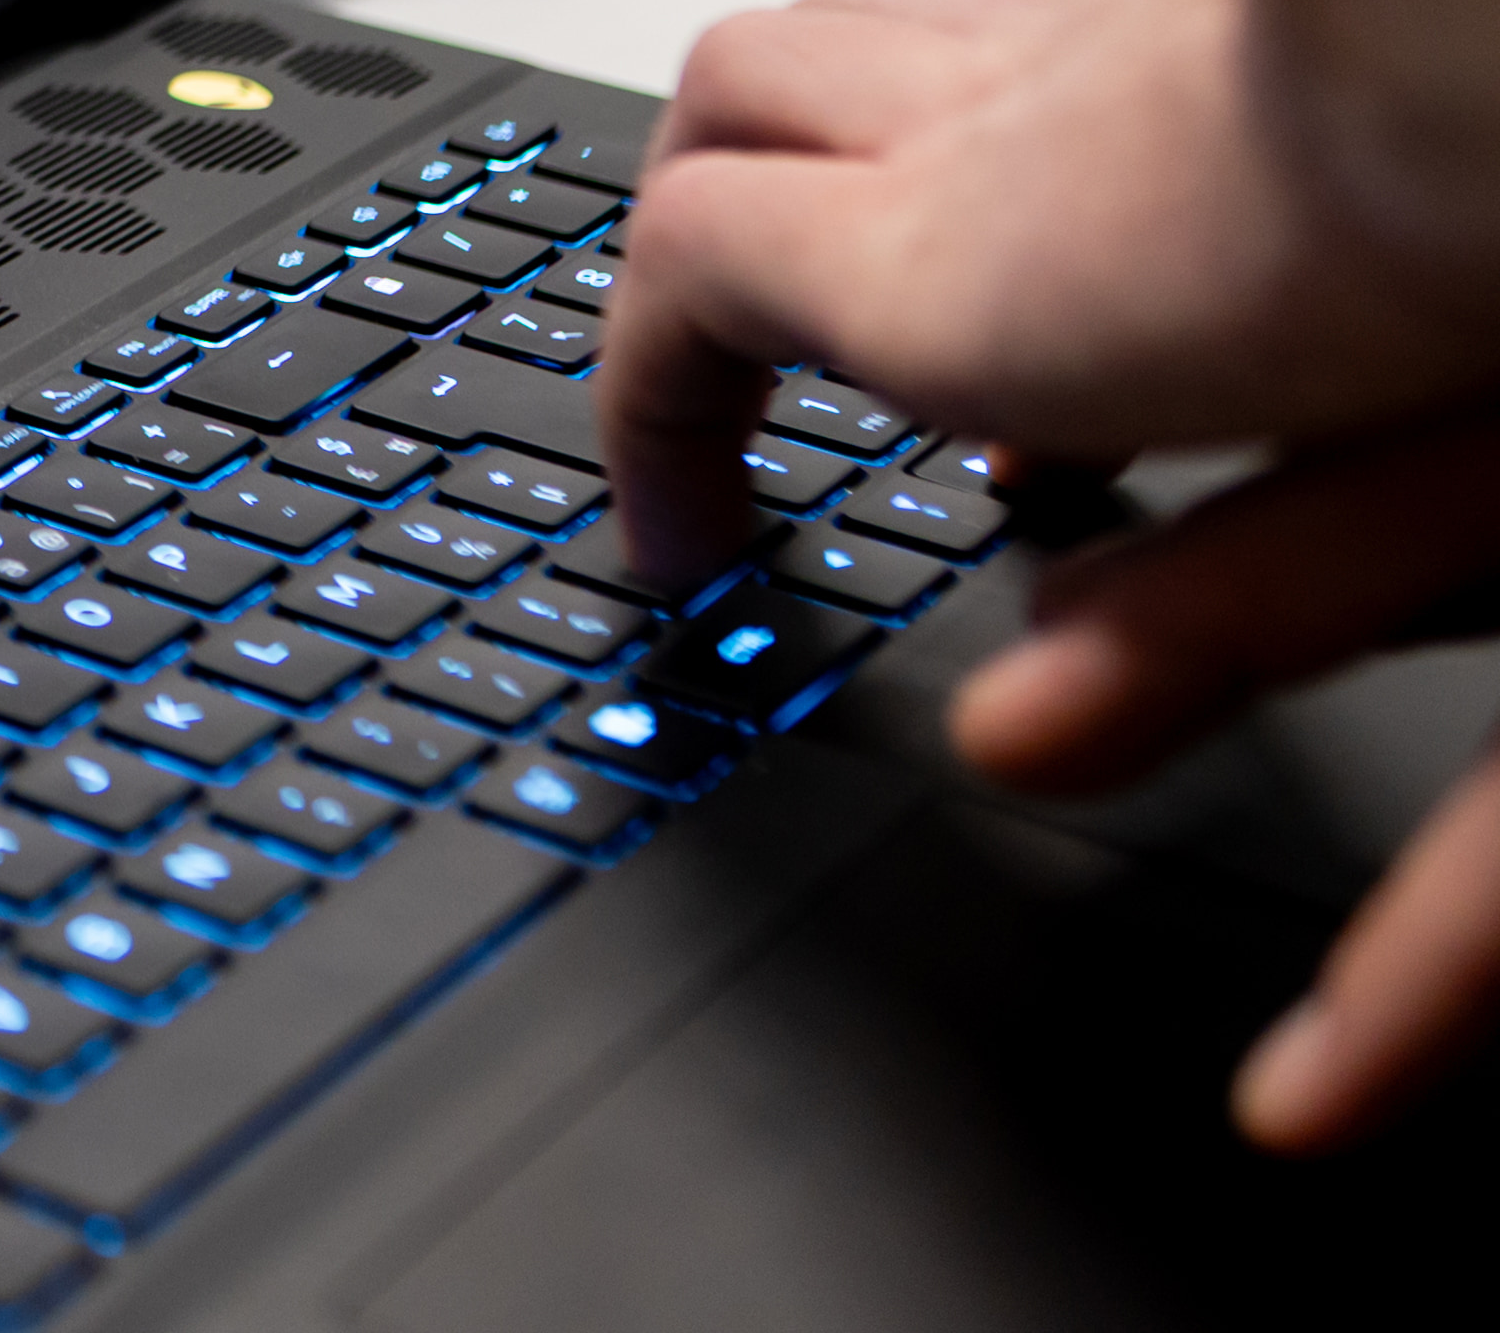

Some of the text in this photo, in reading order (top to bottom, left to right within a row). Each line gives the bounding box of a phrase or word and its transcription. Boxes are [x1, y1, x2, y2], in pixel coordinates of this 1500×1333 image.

[575, 269, 614, 288] 8
[501, 313, 538, 331] 7
[799, 397, 840, 414] 1
[317, 437, 354, 456] $
[148, 544, 187, 572] P
[317, 574, 375, 608] M
[63, 598, 113, 628] O
[235, 640, 290, 666] L
[144, 694, 203, 731] K
[66, 756, 111, 794] J
